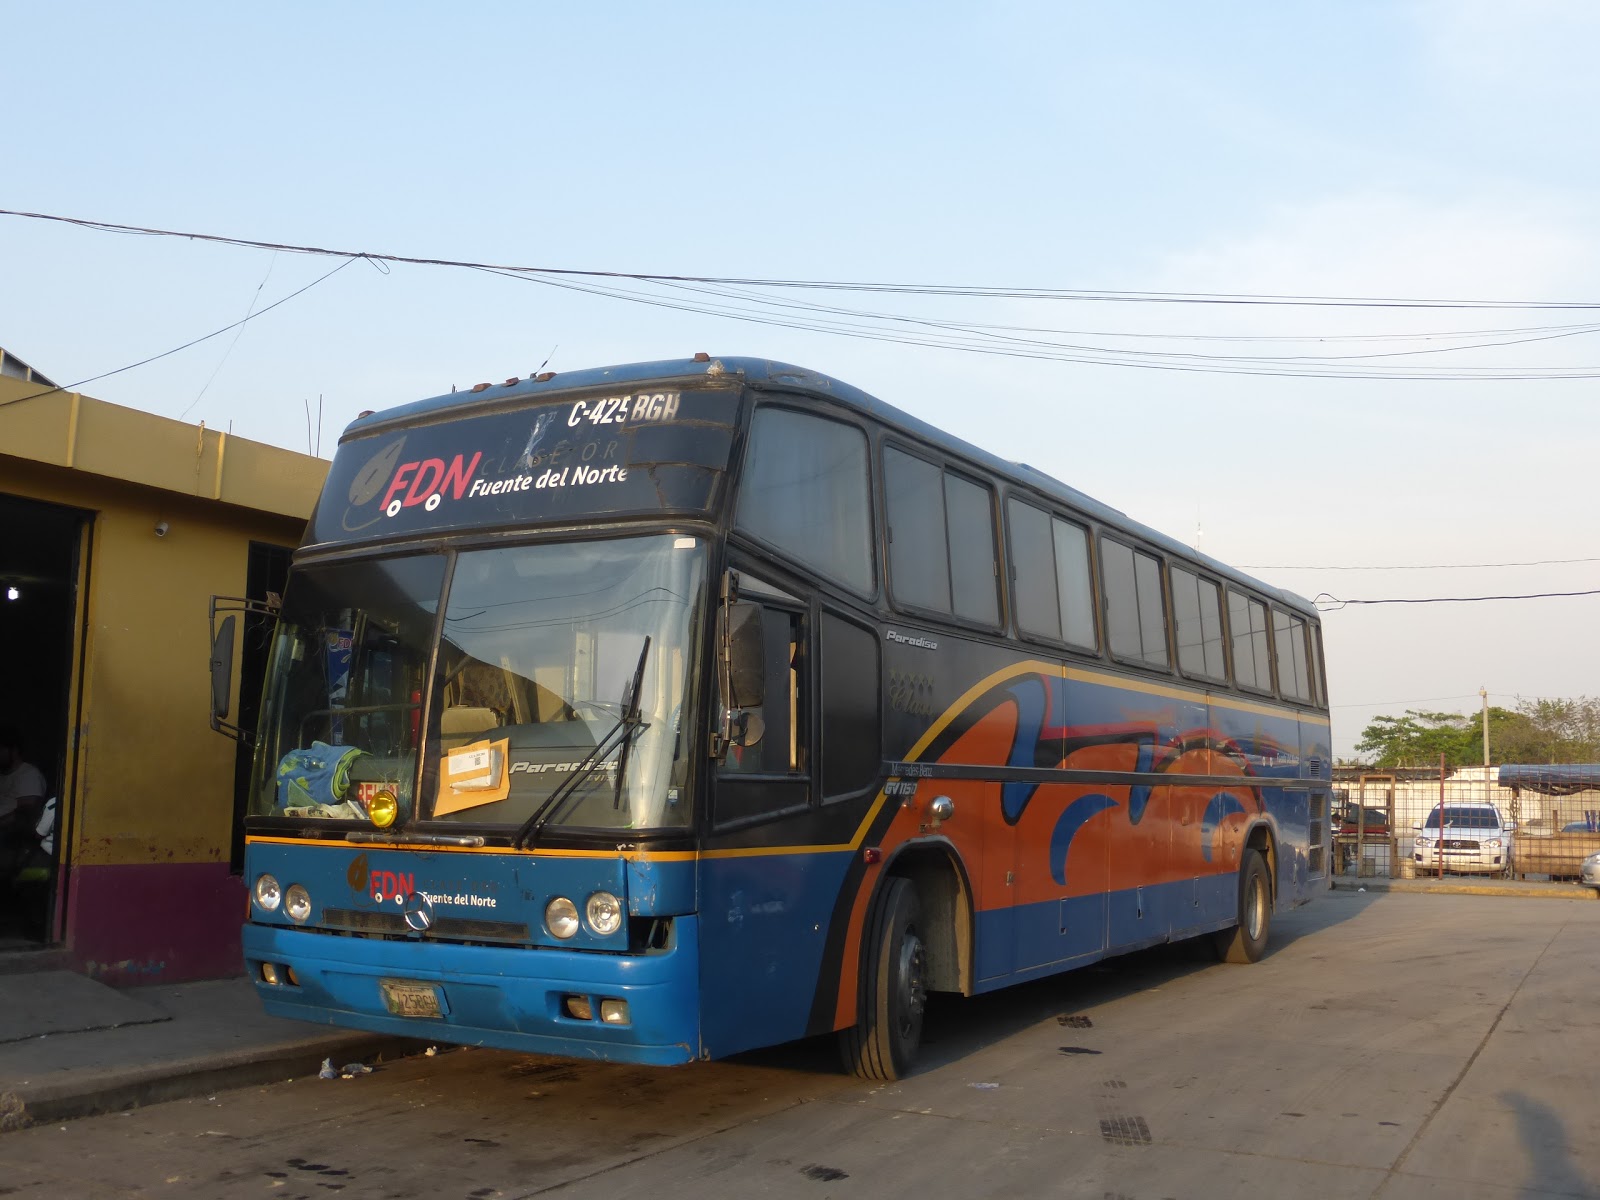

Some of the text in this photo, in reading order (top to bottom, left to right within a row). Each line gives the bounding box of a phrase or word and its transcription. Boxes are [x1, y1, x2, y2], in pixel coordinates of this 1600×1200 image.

[567, 393, 681, 427] C-425 BGH
[378, 451, 483, 512] FDN
[468, 464, 629, 498] Fuente del Norte
[338, 637, 353, 649] FD
[886, 630, 938, 650] Paradiso
[370, 870, 415, 900] FDN
[422, 891, 497, 908] Fuente del Norte
